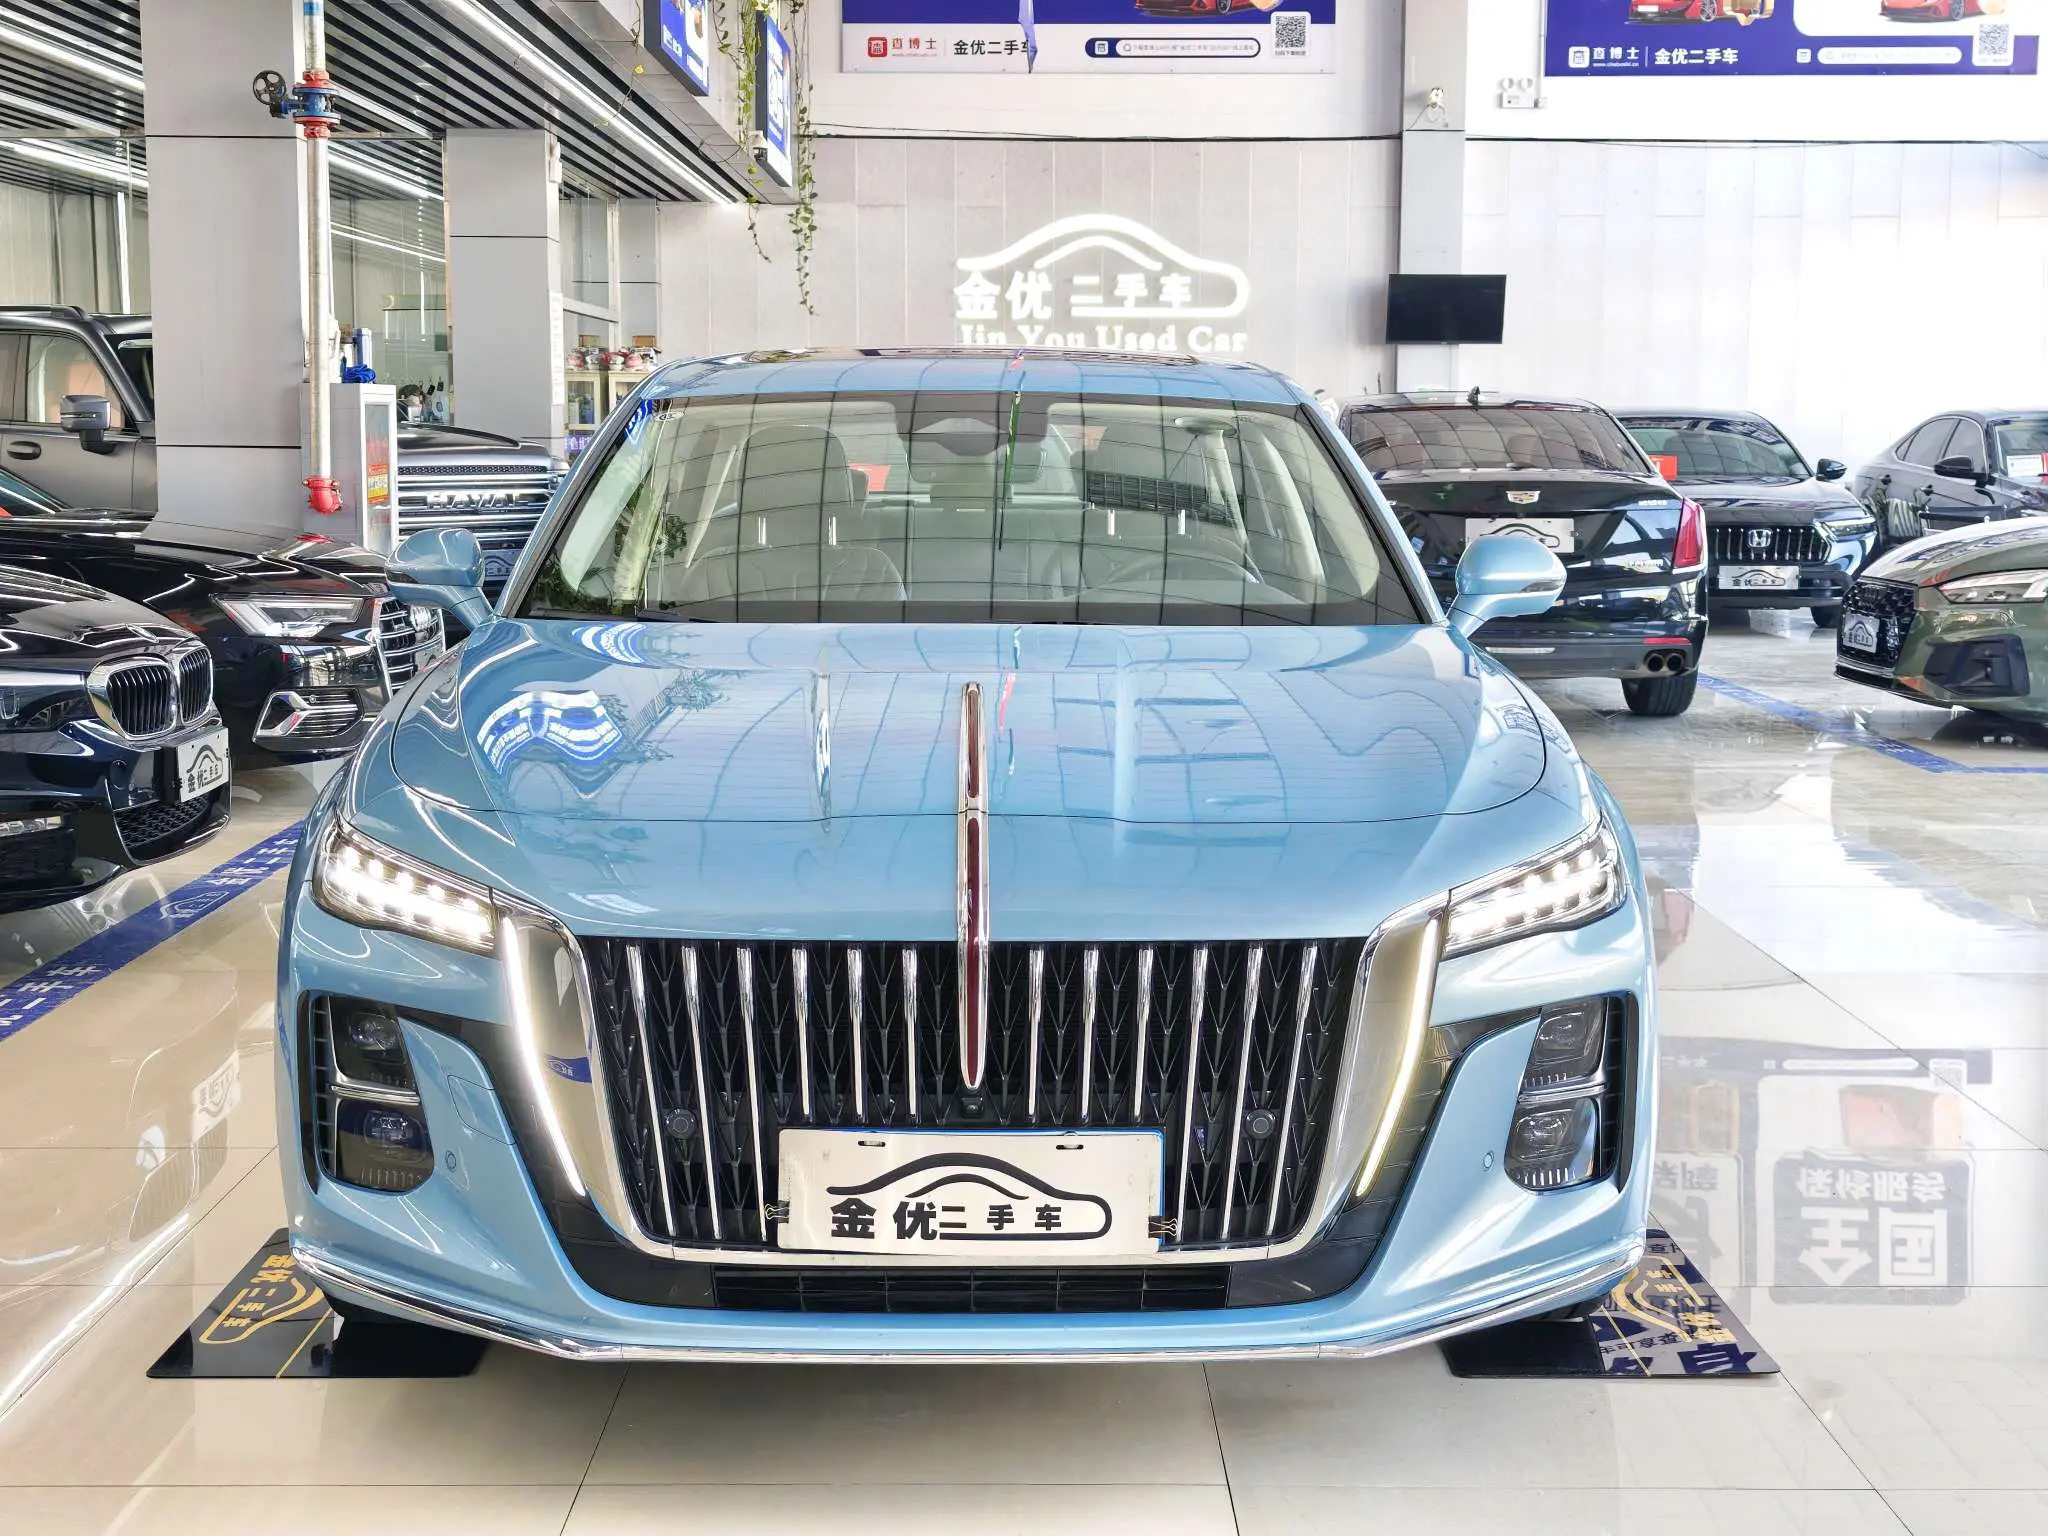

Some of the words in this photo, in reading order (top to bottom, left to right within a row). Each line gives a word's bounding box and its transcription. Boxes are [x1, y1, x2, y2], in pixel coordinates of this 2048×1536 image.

[1654, 47, 1739, 65] 金优二手车
[953, 269, 1193, 320] 金优二手车
[960, 324, 1006, 346] Jin
[1016, 324, 1086, 349] You
[1095, 324, 1178, 351] Used
[1187, 325, 1248, 351] Car
[830, 1197, 1062, 1241] 金优二手车
